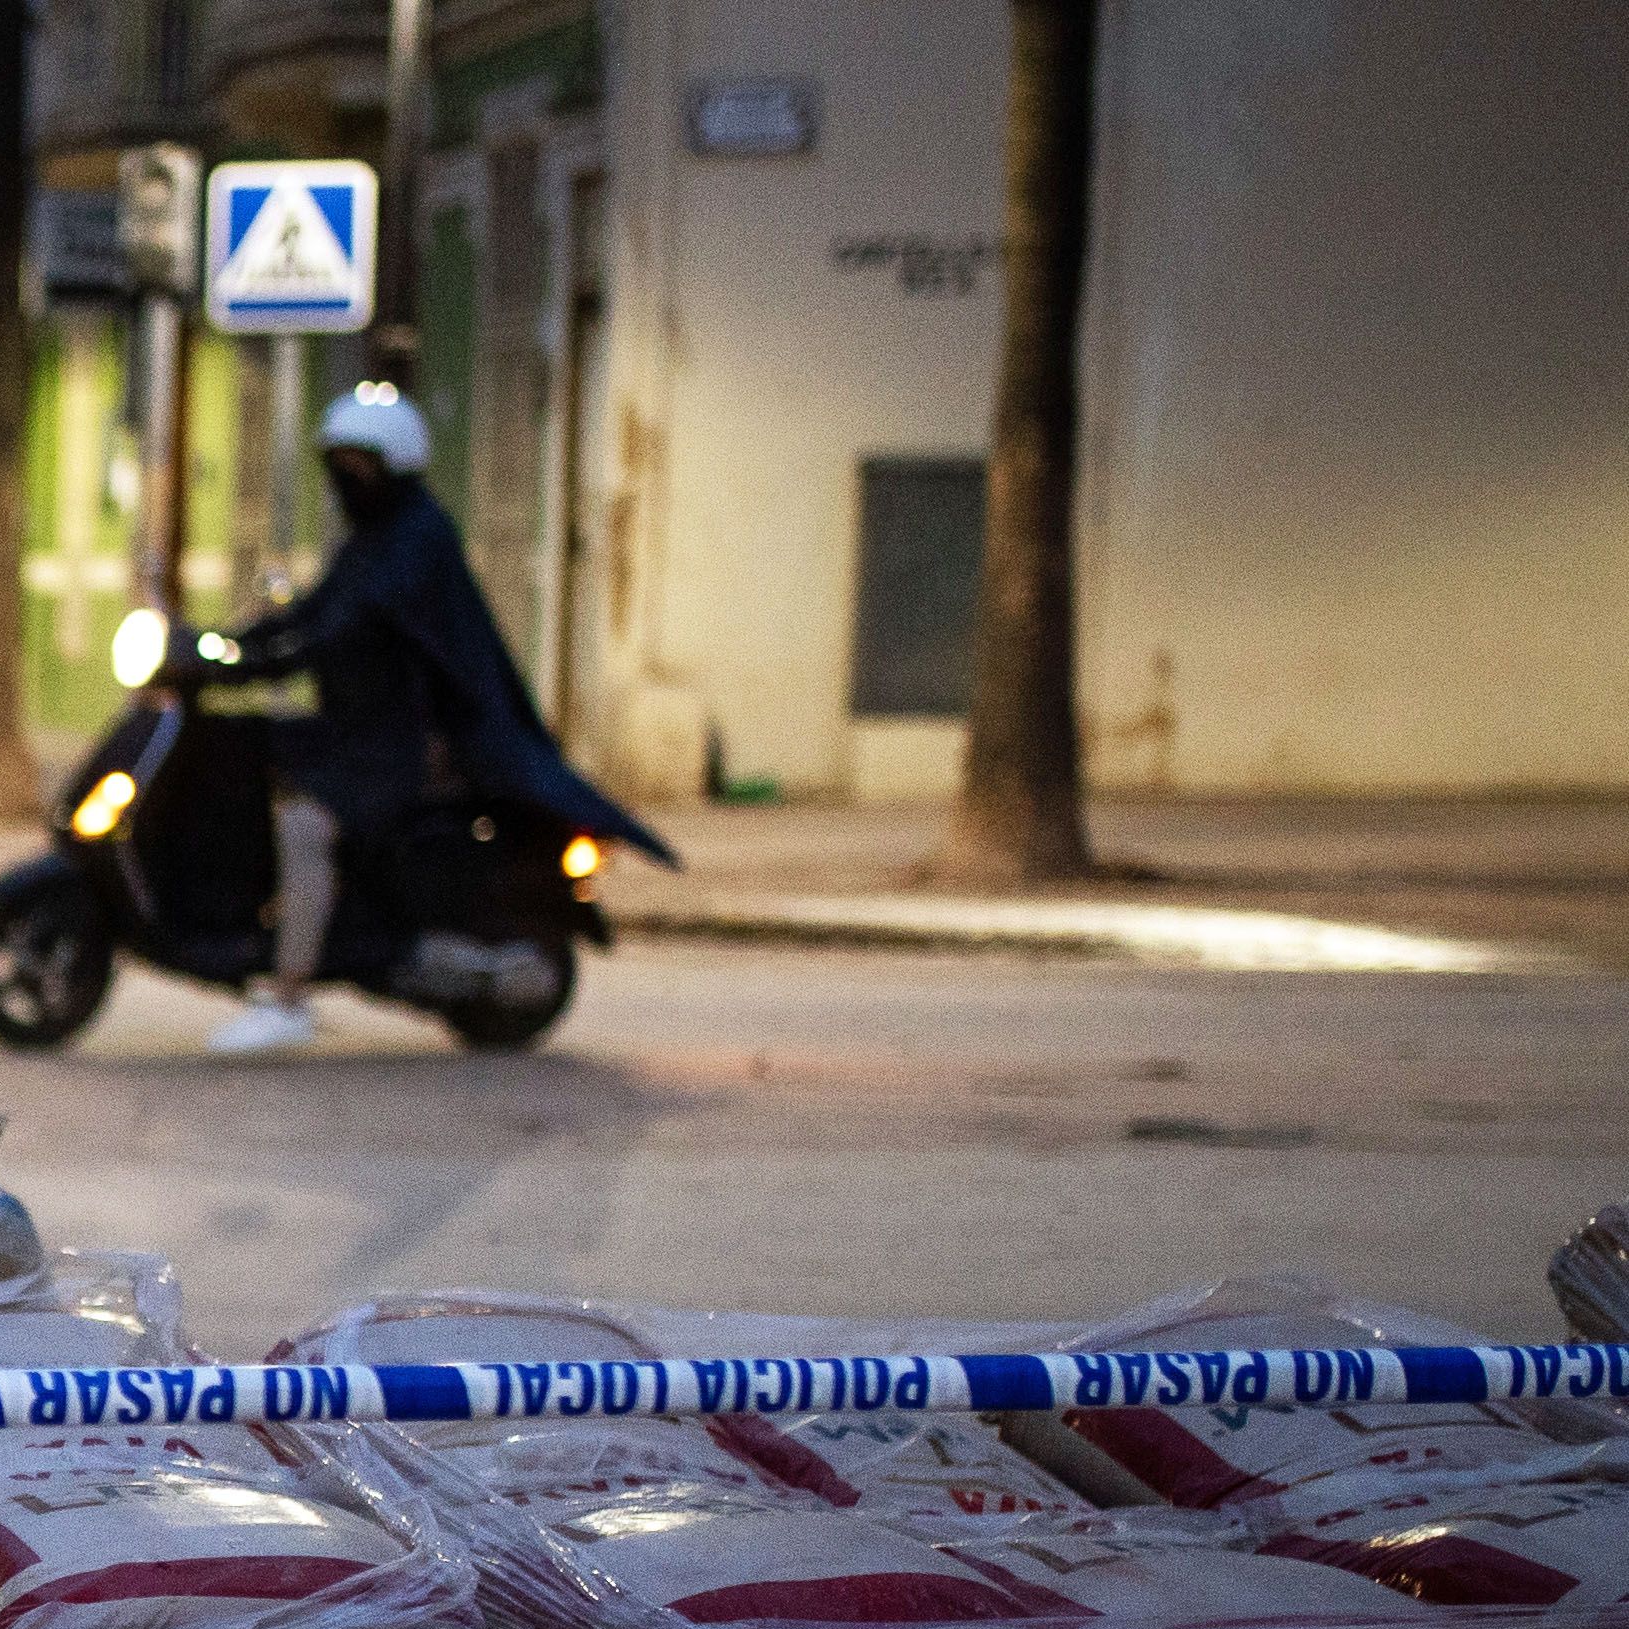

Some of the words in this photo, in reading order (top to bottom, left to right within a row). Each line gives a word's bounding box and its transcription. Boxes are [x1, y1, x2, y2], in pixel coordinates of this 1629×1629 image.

[29, 1369, 236, 1425] PASAR
[264, 1367, 350, 1418] NO
[483, 1360, 669, 1415] LOCAL
[690, 1356, 930, 1412] POLICIA
[1072, 1351, 1272, 1404] PASAR
[1290, 1347, 1377, 1396] NO
